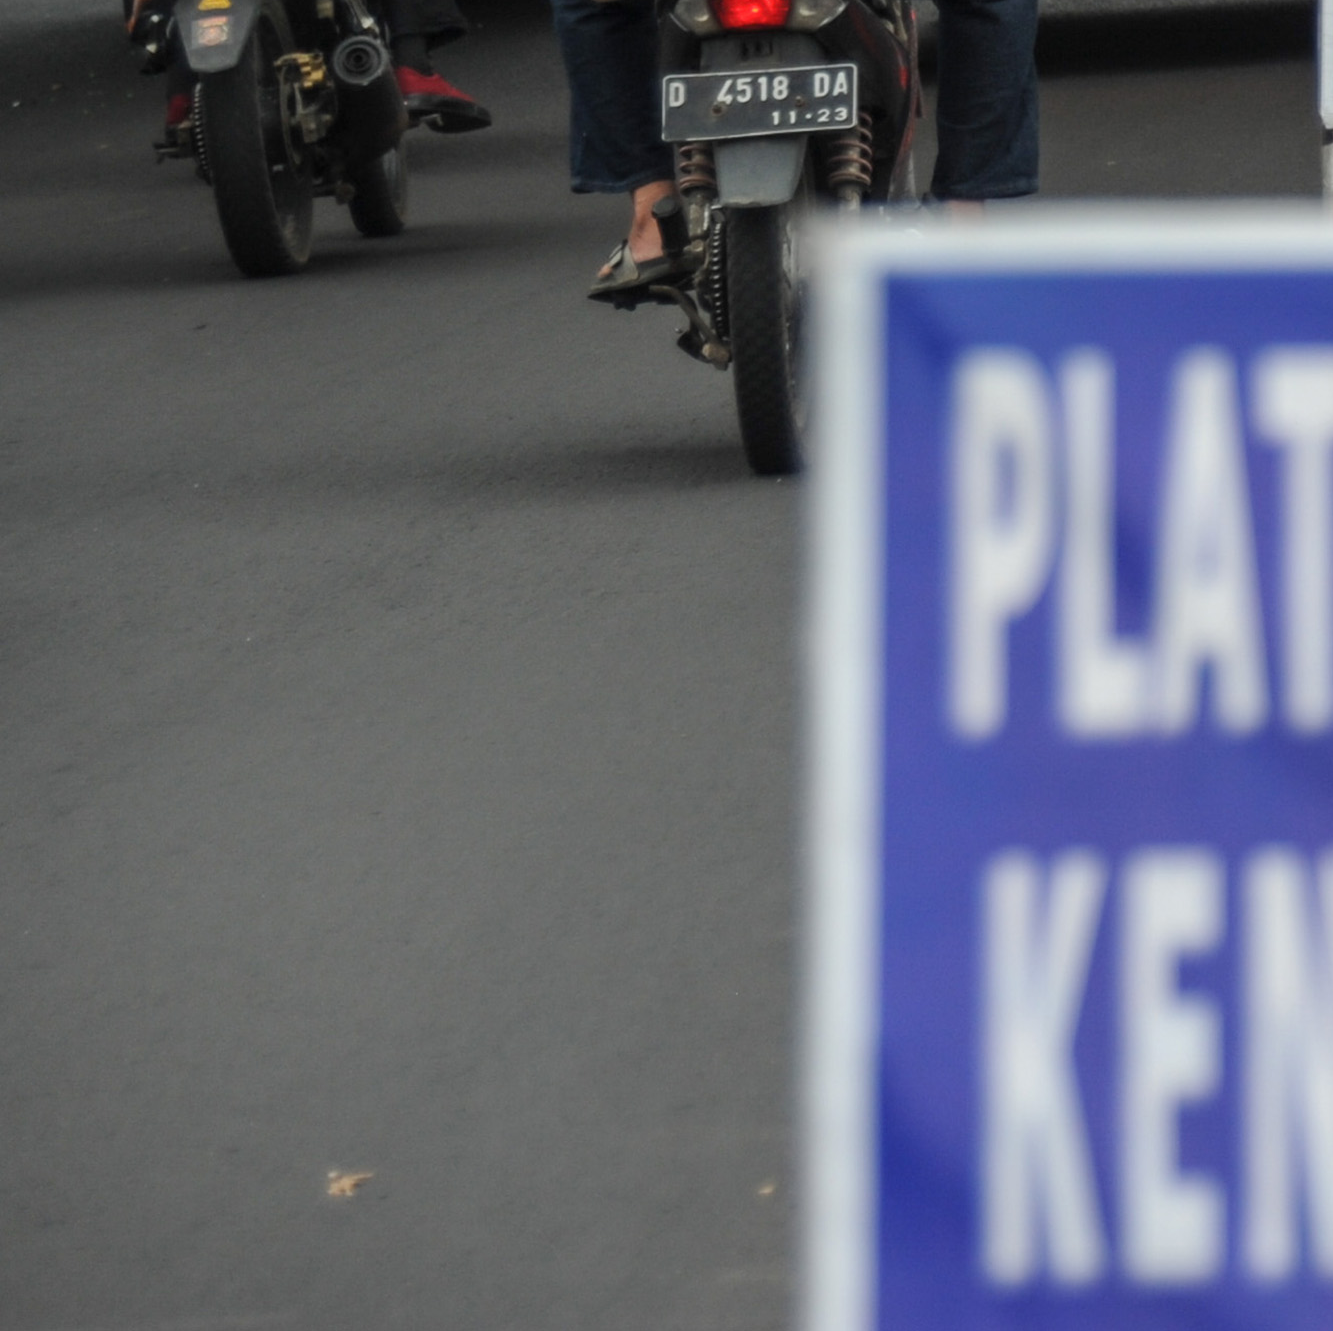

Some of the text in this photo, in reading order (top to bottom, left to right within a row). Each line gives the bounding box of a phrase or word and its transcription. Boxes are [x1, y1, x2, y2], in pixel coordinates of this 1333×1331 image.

[669, 71, 848, 107] D 4518 DA
